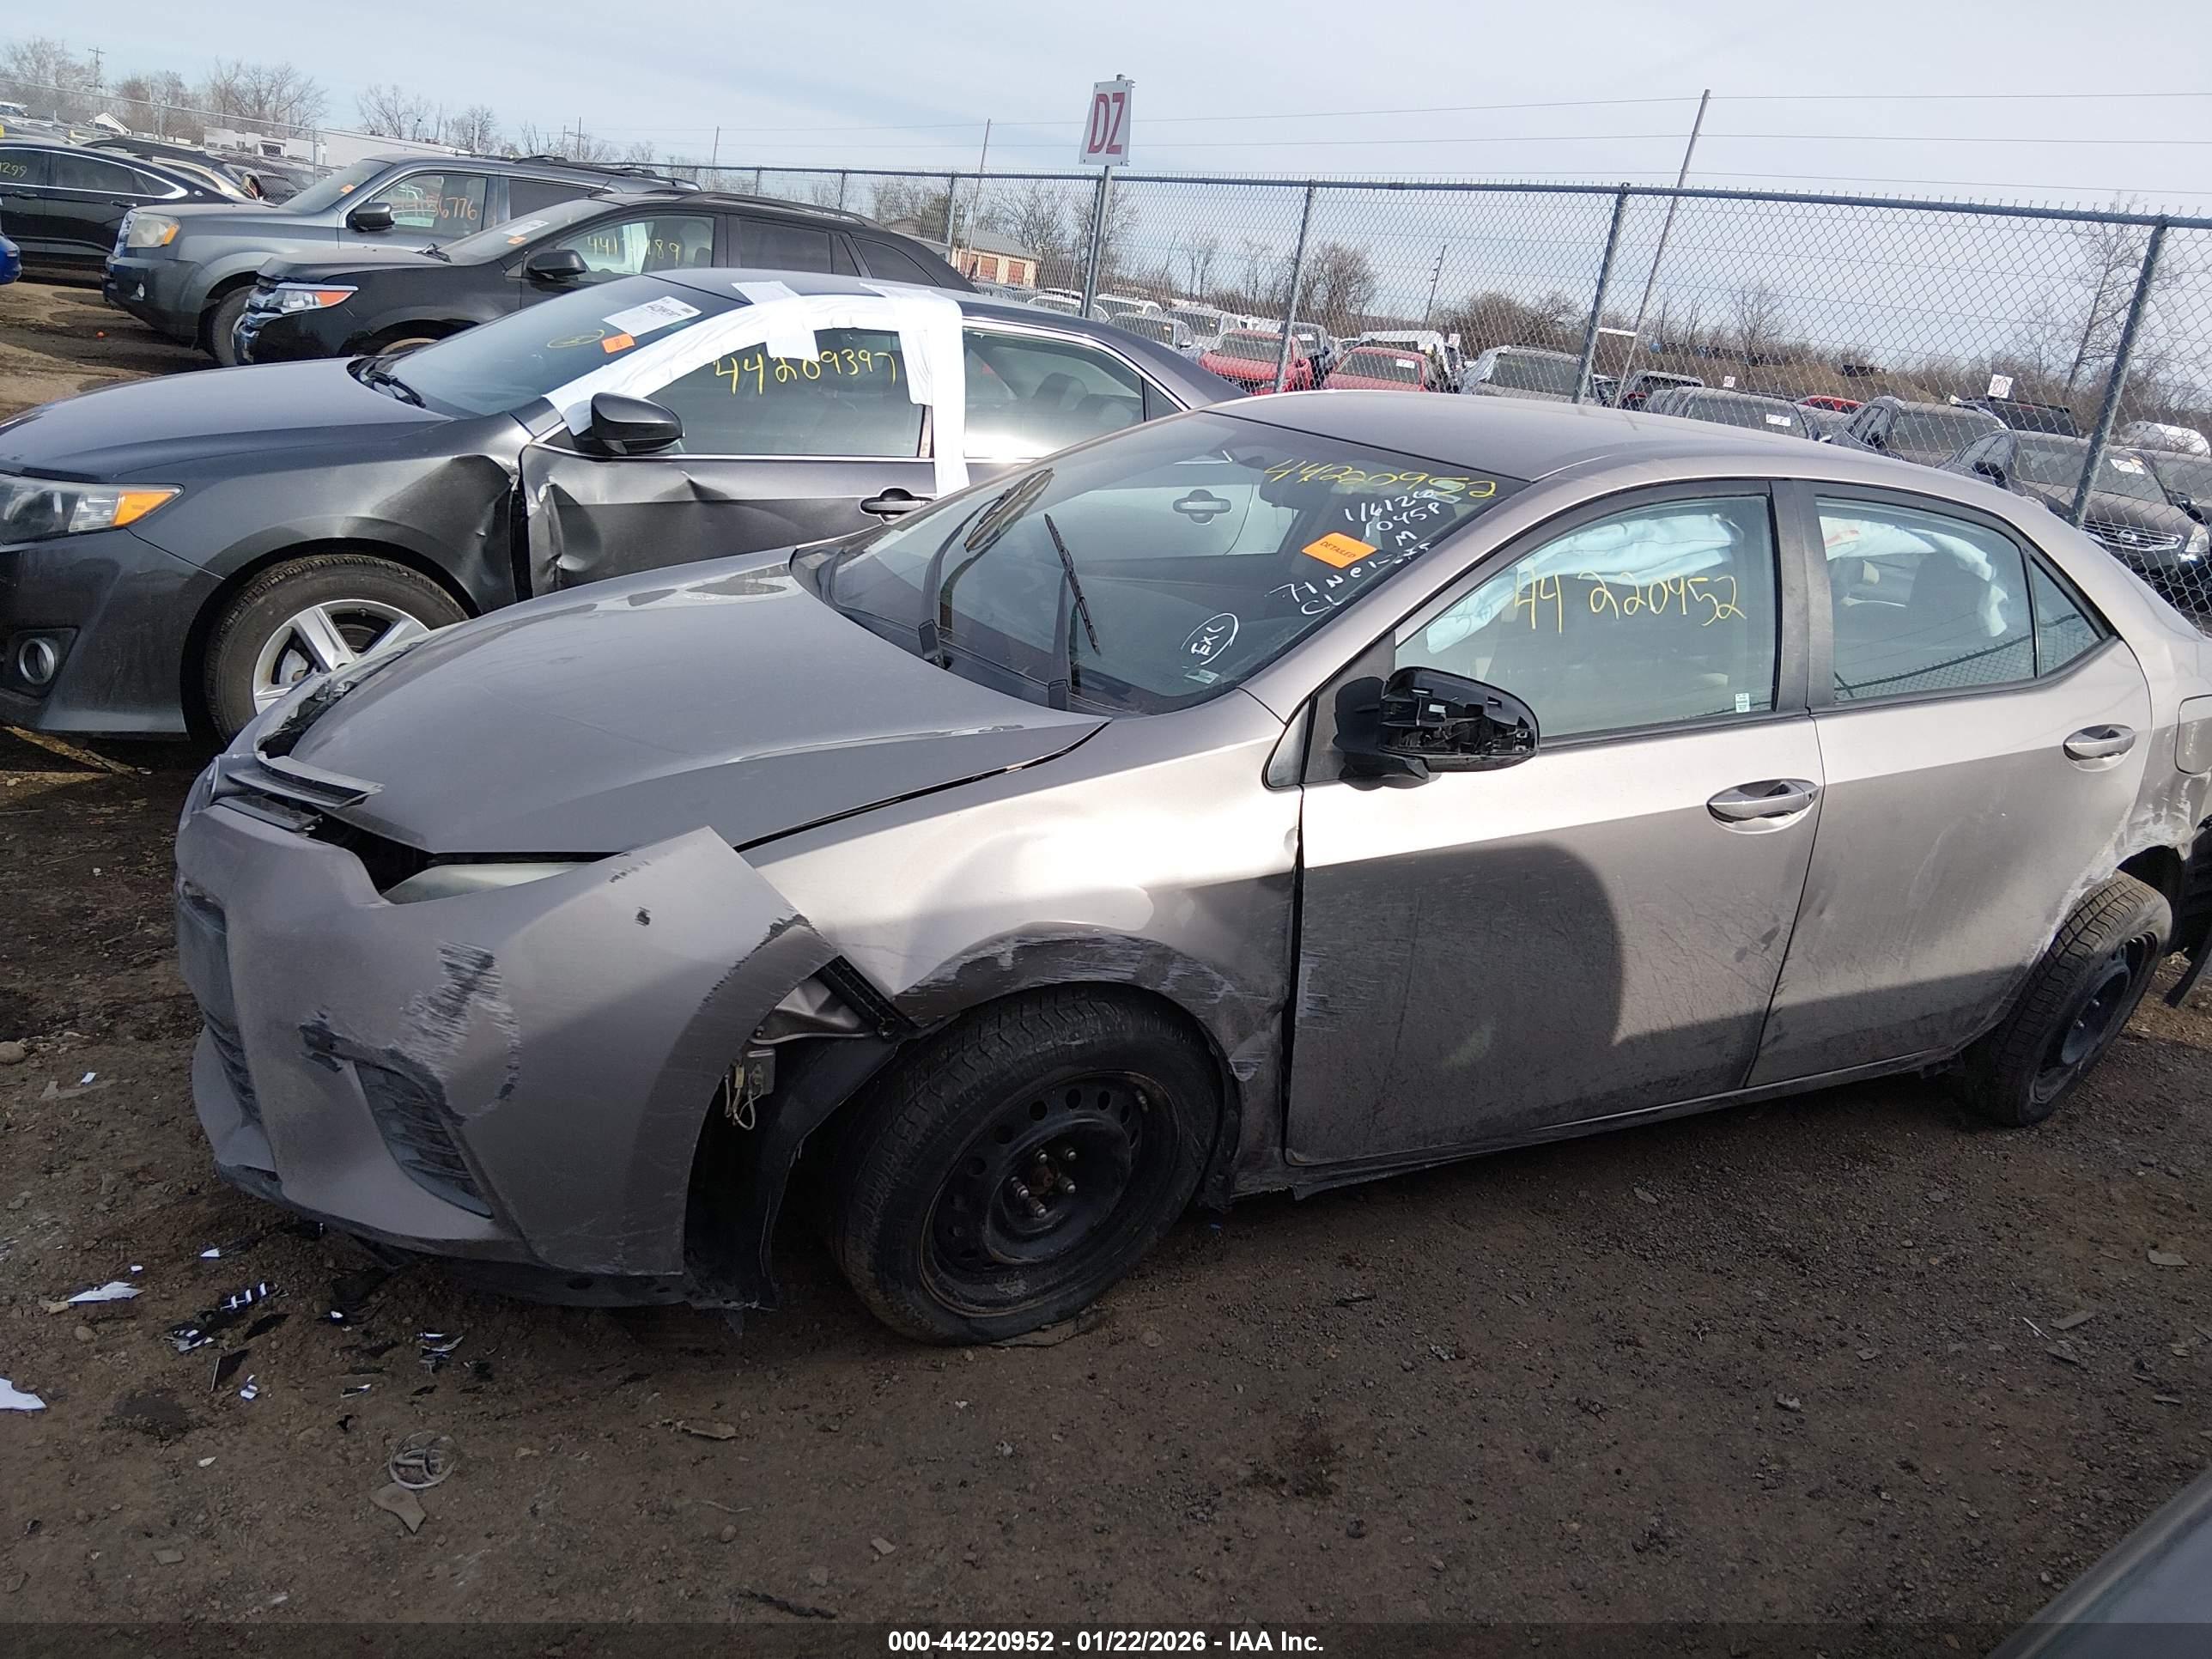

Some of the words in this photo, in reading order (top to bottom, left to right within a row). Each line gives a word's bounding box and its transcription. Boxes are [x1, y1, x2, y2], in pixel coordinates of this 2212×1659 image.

[1087, 92, 1126, 155] DZ
[714, 348, 896, 395] 44209397
[1264, 459, 1497, 498] 44220952
[1320, 540, 1357, 559] DETAILED
